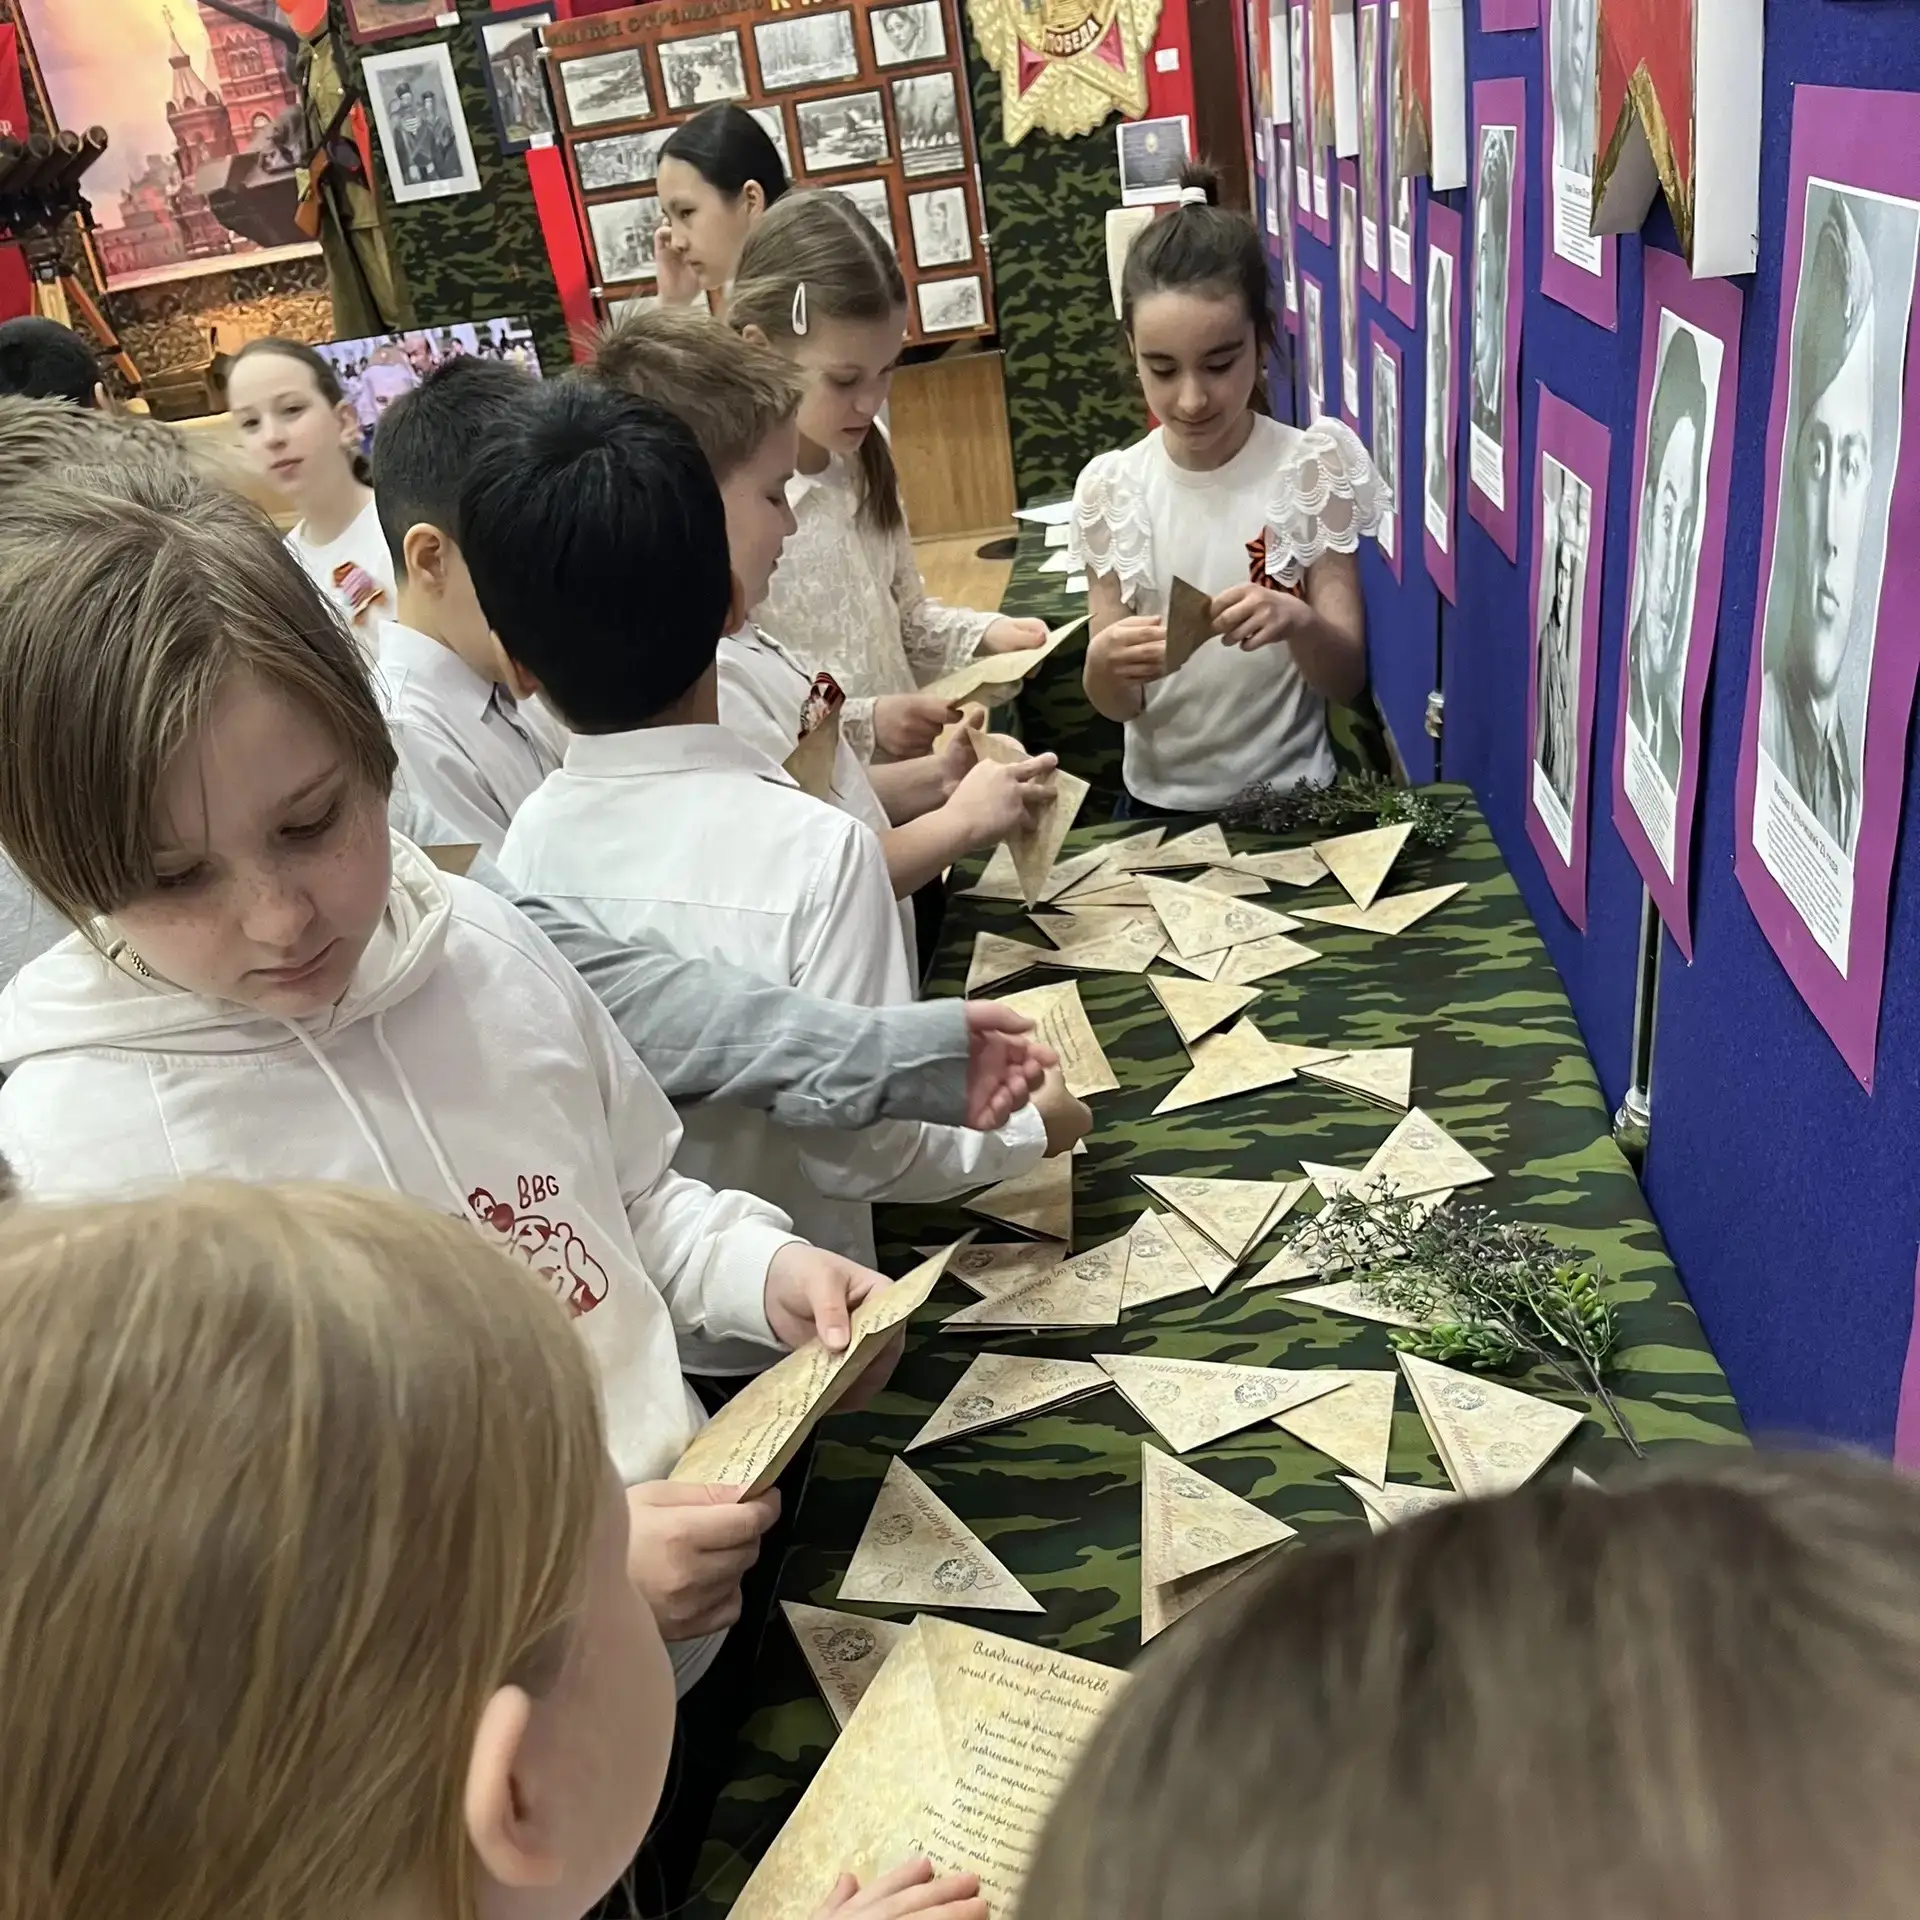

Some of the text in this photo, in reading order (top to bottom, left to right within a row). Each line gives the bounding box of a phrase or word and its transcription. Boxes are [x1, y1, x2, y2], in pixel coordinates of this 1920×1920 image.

[1044, 18, 1101, 54] ПОБЕДА
[517, 1174, 560, 1210] BBG
[972, 1640, 1110, 1694] Владимир Калачёв,
